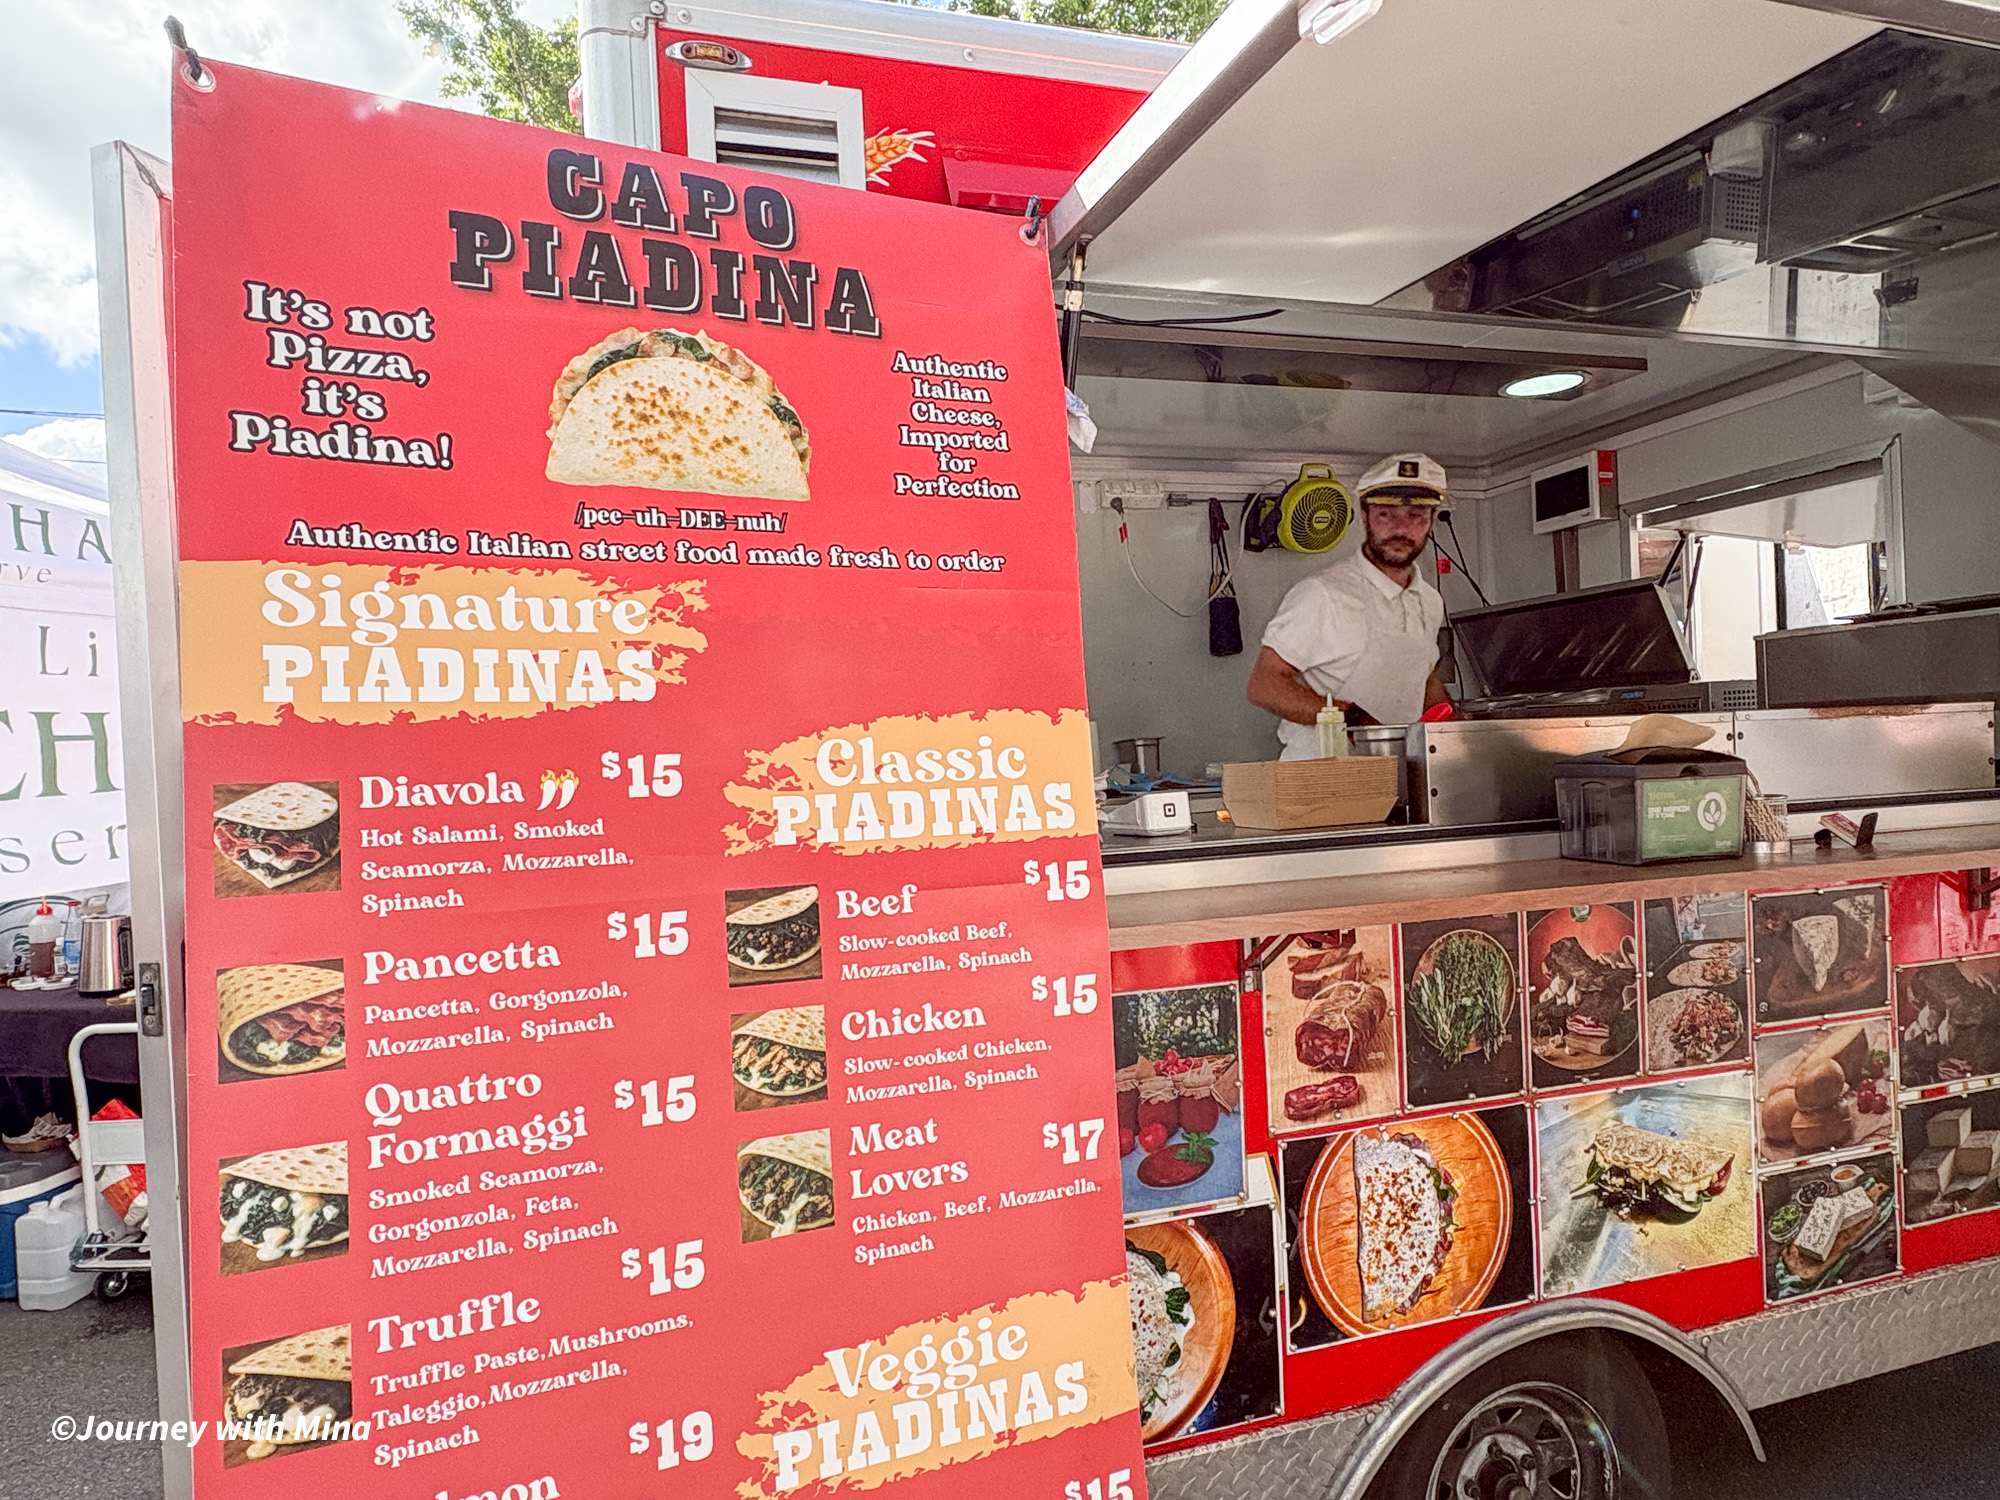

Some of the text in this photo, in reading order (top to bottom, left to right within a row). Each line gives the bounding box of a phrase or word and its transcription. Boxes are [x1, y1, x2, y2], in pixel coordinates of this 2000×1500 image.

[547, 149, 797, 252] CAPO
[448, 210, 883, 340] PIADINA
[348, 310, 432, 340] not
[268, 329, 430, 386] Pizza,
[893, 352, 1007, 380] Authentic
[911, 402, 1000, 429] Cheese,
[913, 378, 991, 403] Italian
[232, 413, 450, 468] Piadina!
[900, 421, 1009, 452] Imported
[939, 451, 976, 472] for
[895, 474, 1019, 499] Perfection
[6, 502, 113, 564] HA
[287, 520, 1005, 571] Authentic Italian street food made fresh to order
[261, 569, 650, 647] Signature
[262, 644, 657, 704] PIADINAS
[359, 750, 683, 809] Diavola $15
[816, 735, 1027, 787] Classic
[360, 818, 605, 848] Hot Salami, Smoked
[772, 782, 1076, 846] PIADINAS
[361, 847, 634, 881] Scamorza, Mozzarella,
[835, 859, 1091, 919] Beef $15
[361, 888, 465, 918] Spinach
[363, 910, 689, 985] Pancetta $15
[965, 921, 1012, 941] Beef,
[840, 946, 1033, 981] Mozzarella, Spinach
[364, 980, 628, 1025] Pancetta, Gorgonzola,
[841, 973, 1098, 1041] Chicken $15
[365, 1011, 615, 1058] Mozzarella, Spinach
[973, 1037, 1052, 1059] Chicken,
[365, 1073, 697, 1128] Quattro $15
[846, 1063, 1039, 1104] Mozzarella, Spinach
[365, 1103, 589, 1169] Formaggi
[848, 1117, 1105, 1165] Meat $17
[368, 1160, 604, 1210] Smoked Scamorza,
[849, 1161, 969, 1200] Lovers
[366, 1195, 579, 1244] Gorgonzola, Feta,
[852, 1177, 1101, 1235] Chicken, Beef, Mozzarella,
[370, 1216, 619, 1279] Mozzarella, Spinach
[855, 1234, 935, 1266] Spinach
[365, 1239, 705, 1355] Truffle $15
[370, 1360, 466, 1396] Truffle
[823, 1314, 1030, 1400] Veggie
[374, 1410, 714, 1471] Spinach $19
[769, 1358, 1089, 1493] PIADINAS
